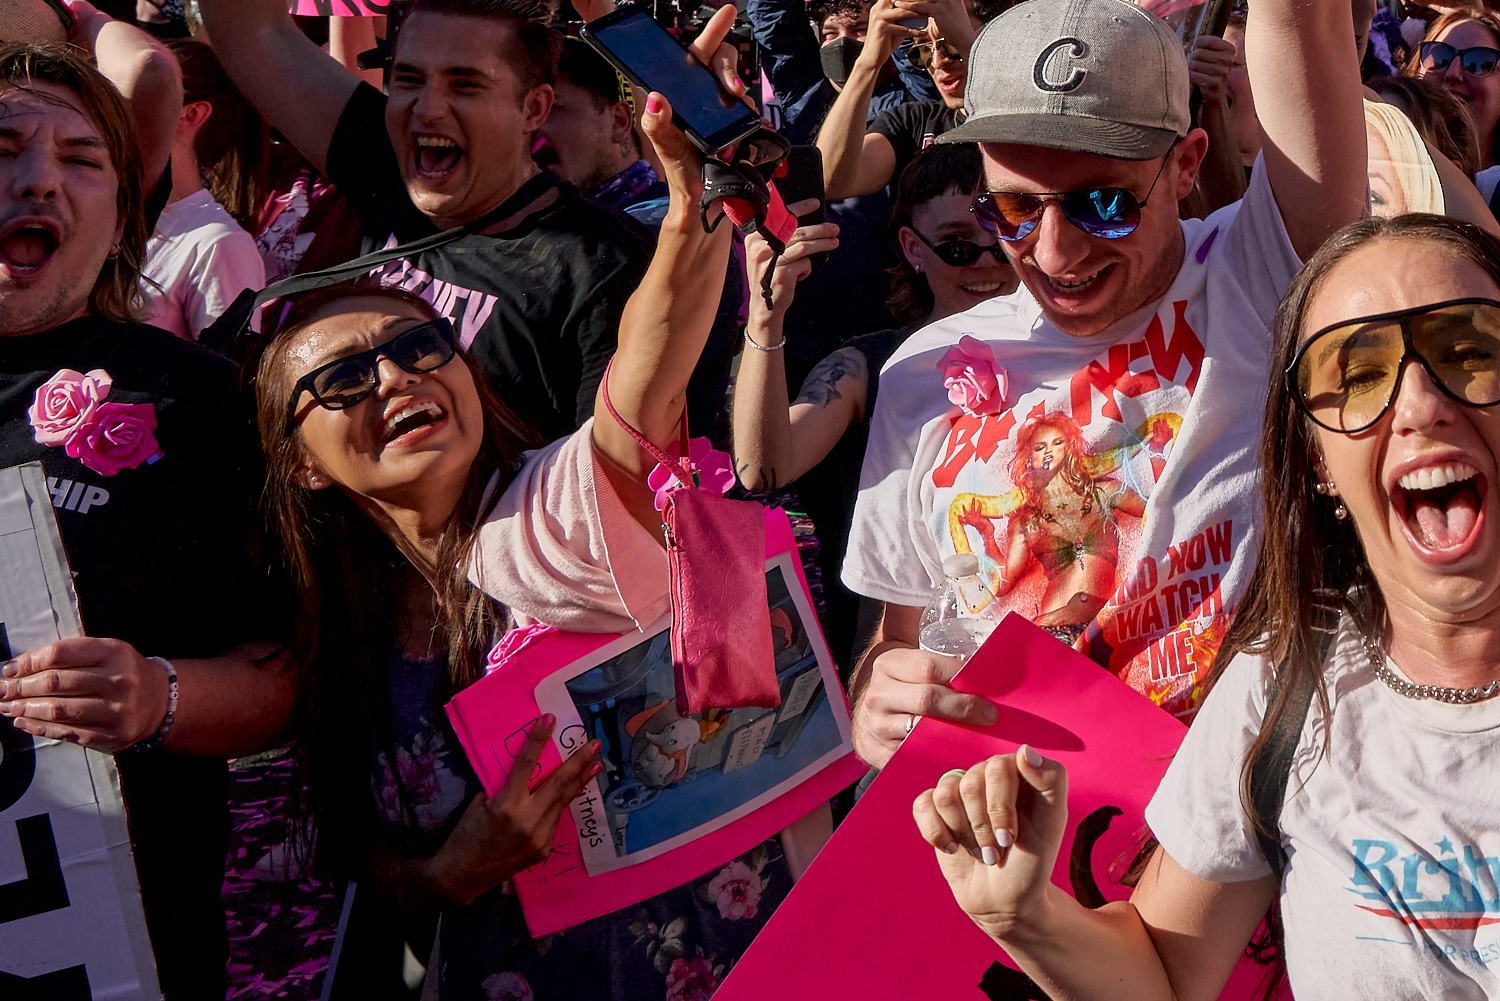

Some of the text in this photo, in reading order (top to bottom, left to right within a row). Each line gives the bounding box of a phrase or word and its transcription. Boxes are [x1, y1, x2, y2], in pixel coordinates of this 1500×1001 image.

[1032, 36, 1088, 94] C
[1116, 573, 1224, 643] WATCH
[1148, 629, 1197, 682] ME
